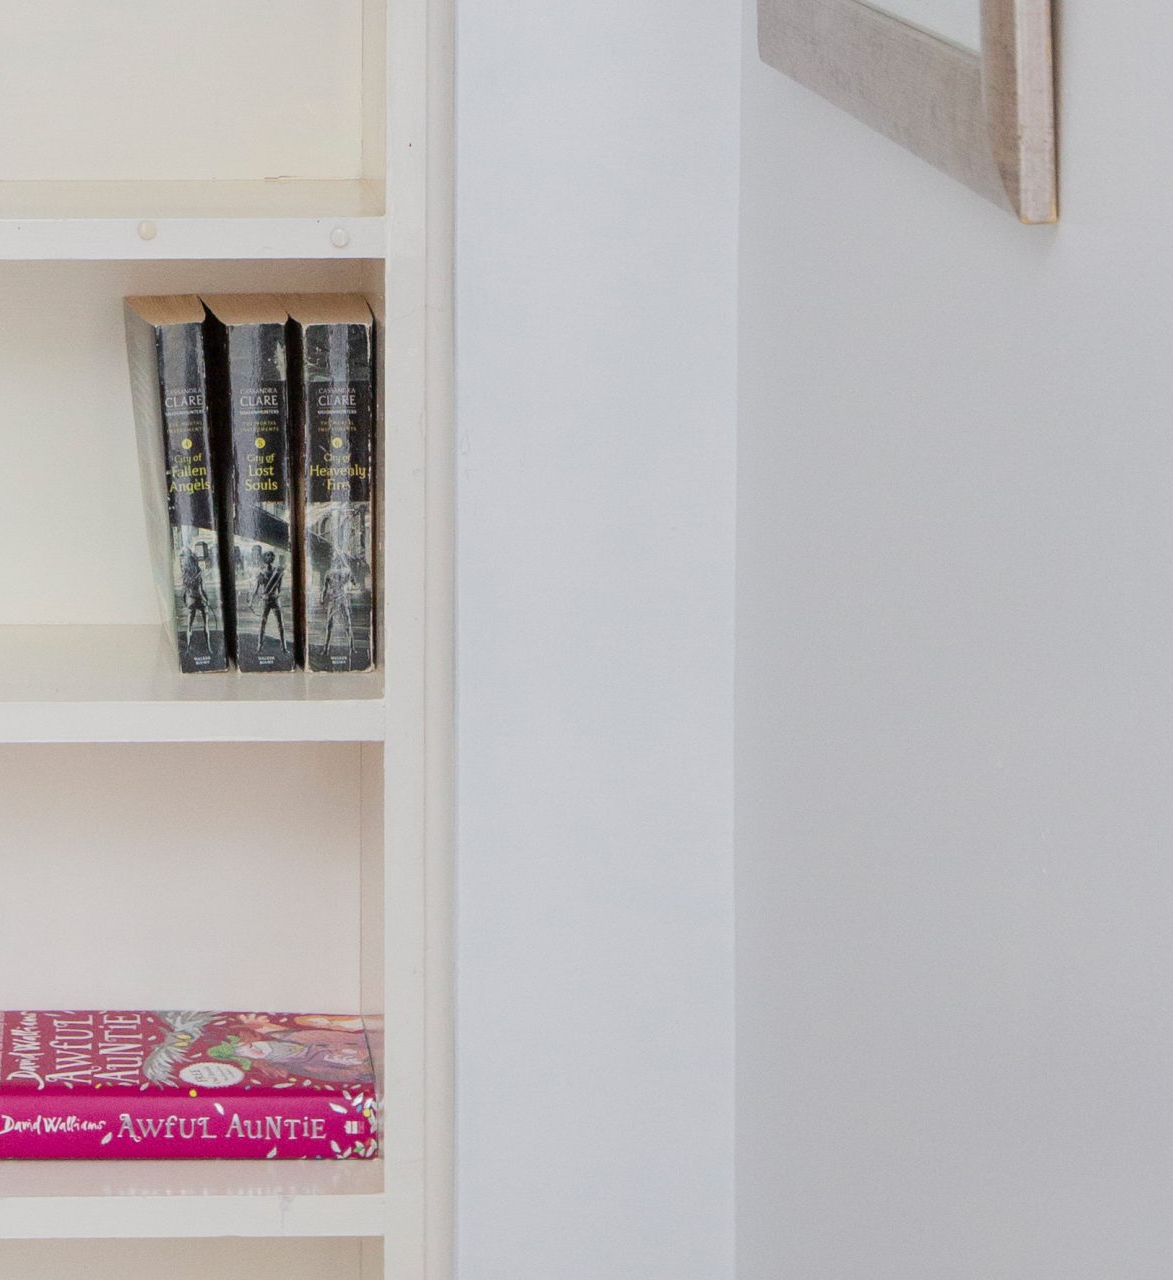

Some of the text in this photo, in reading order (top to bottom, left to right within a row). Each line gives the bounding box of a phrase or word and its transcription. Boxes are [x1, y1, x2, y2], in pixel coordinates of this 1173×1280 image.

[165, 395, 204, 408] CLARE
[239, 395, 279, 407] CLARE
[318, 395, 357, 407] CLARE
[174, 453, 202, 464] City of
[247, 453, 275, 463] City of
[323, 452, 352, 463] City of
[171, 464, 207, 478] Fallen
[248, 465, 274, 477] Lost
[310, 464, 367, 480] Heavenly
[169, 478, 211, 494] Angels
[245, 478, 278, 492] Souls
[326, 478, 349, 491] Fire
[5, 1052, 45, 1091] David
[42, 1115, 107, 1134] Walliams
